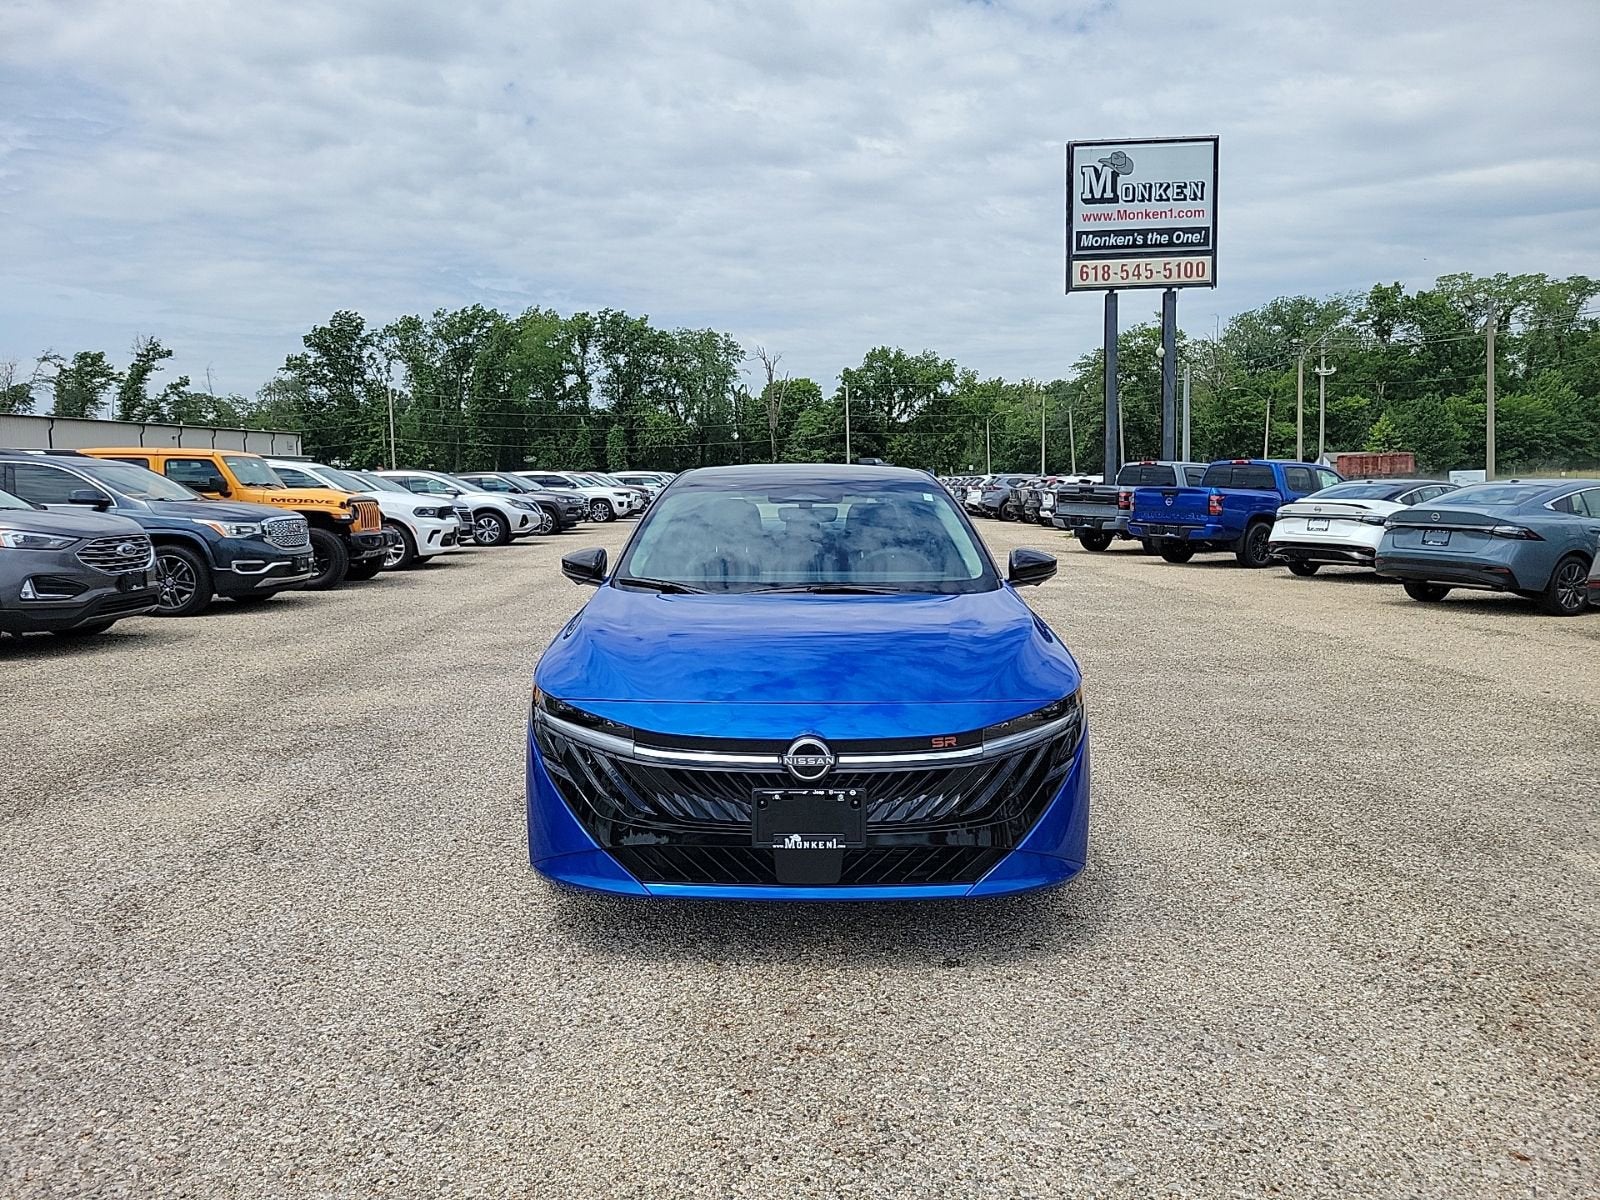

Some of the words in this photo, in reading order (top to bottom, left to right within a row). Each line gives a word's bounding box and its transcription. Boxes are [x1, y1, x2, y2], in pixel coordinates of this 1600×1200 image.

[1081, 165, 1205, 205] MONKEN
[1082, 208, 1205, 222] www.Monken1.com
[1081, 233, 1143, 247] Monken's
[1147, 232, 1169, 244] the
[1173, 231, 1205, 243] One!
[1079, 261, 1206, 282] 618-545-5100
[271, 497, 335, 505] MOJAVE
[931, 737, 957, 748] SR
[784, 757, 834, 765] NISSAN
